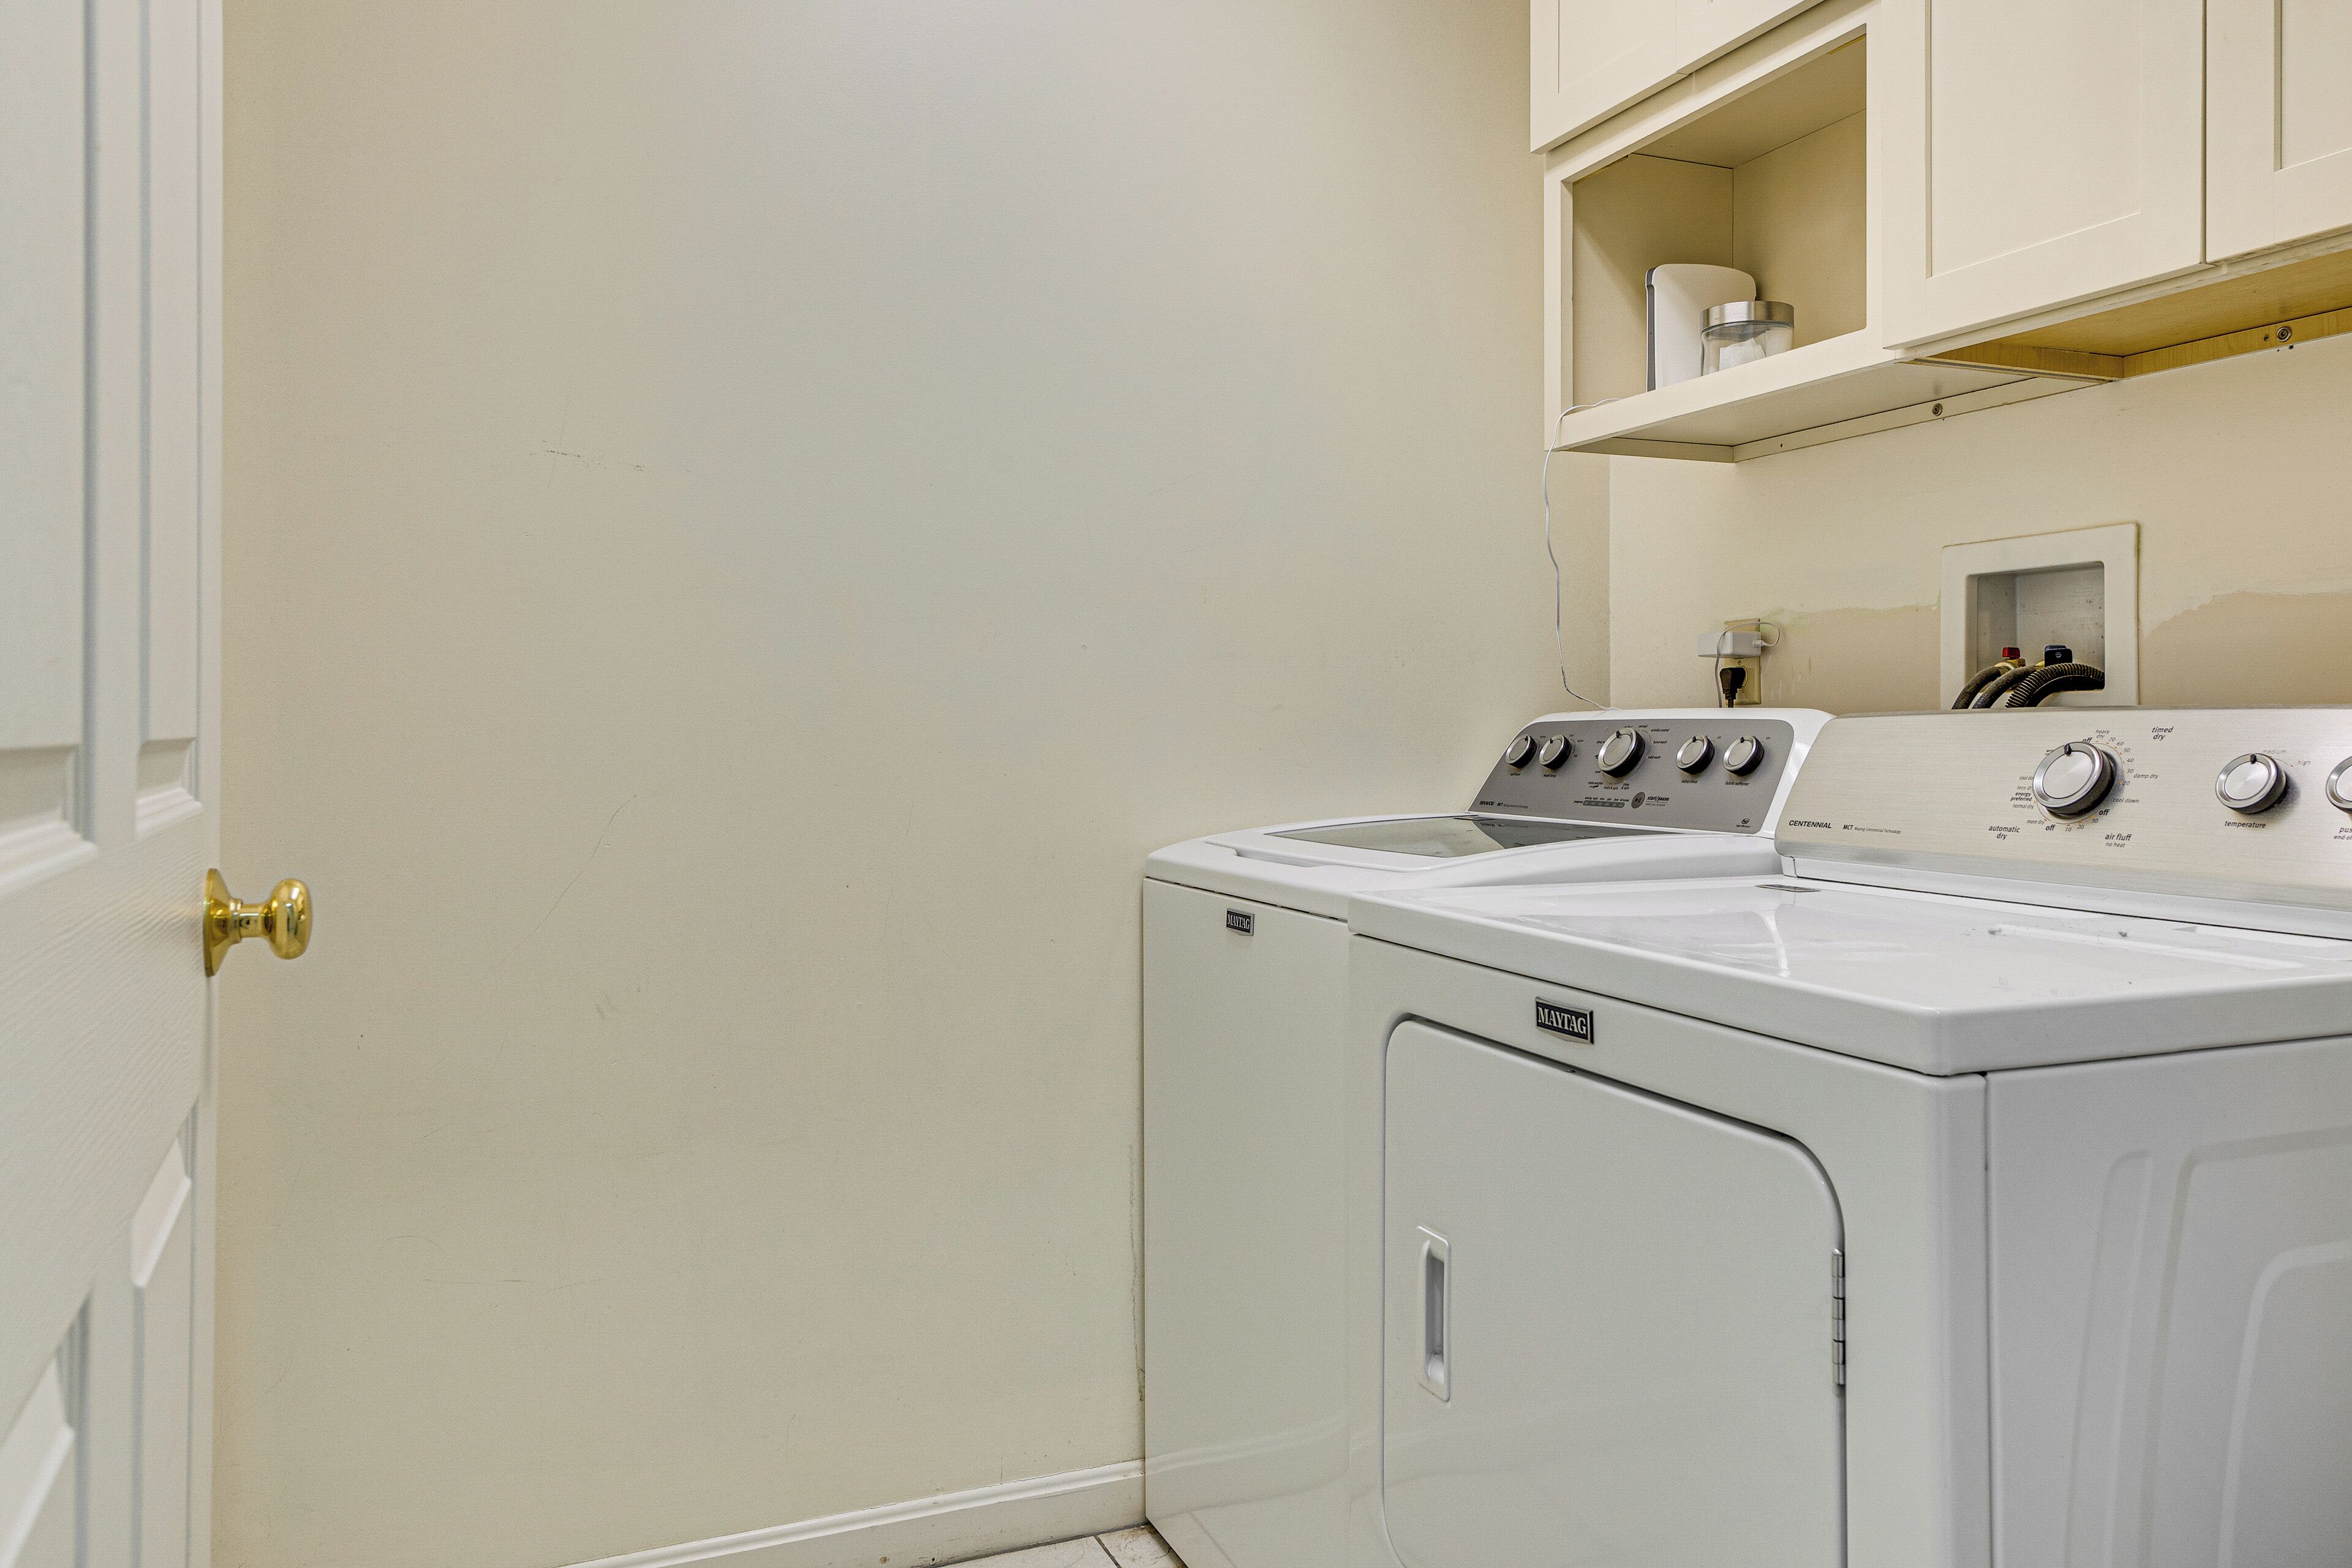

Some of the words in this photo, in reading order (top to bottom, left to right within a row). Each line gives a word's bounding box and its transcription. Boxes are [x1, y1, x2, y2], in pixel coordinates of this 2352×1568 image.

[1789, 820, 1831, 829] CENTENNIAL
[1227, 914, 1250, 929] MAYTAG
[1537, 1006, 1586, 1035] MAYTAG
